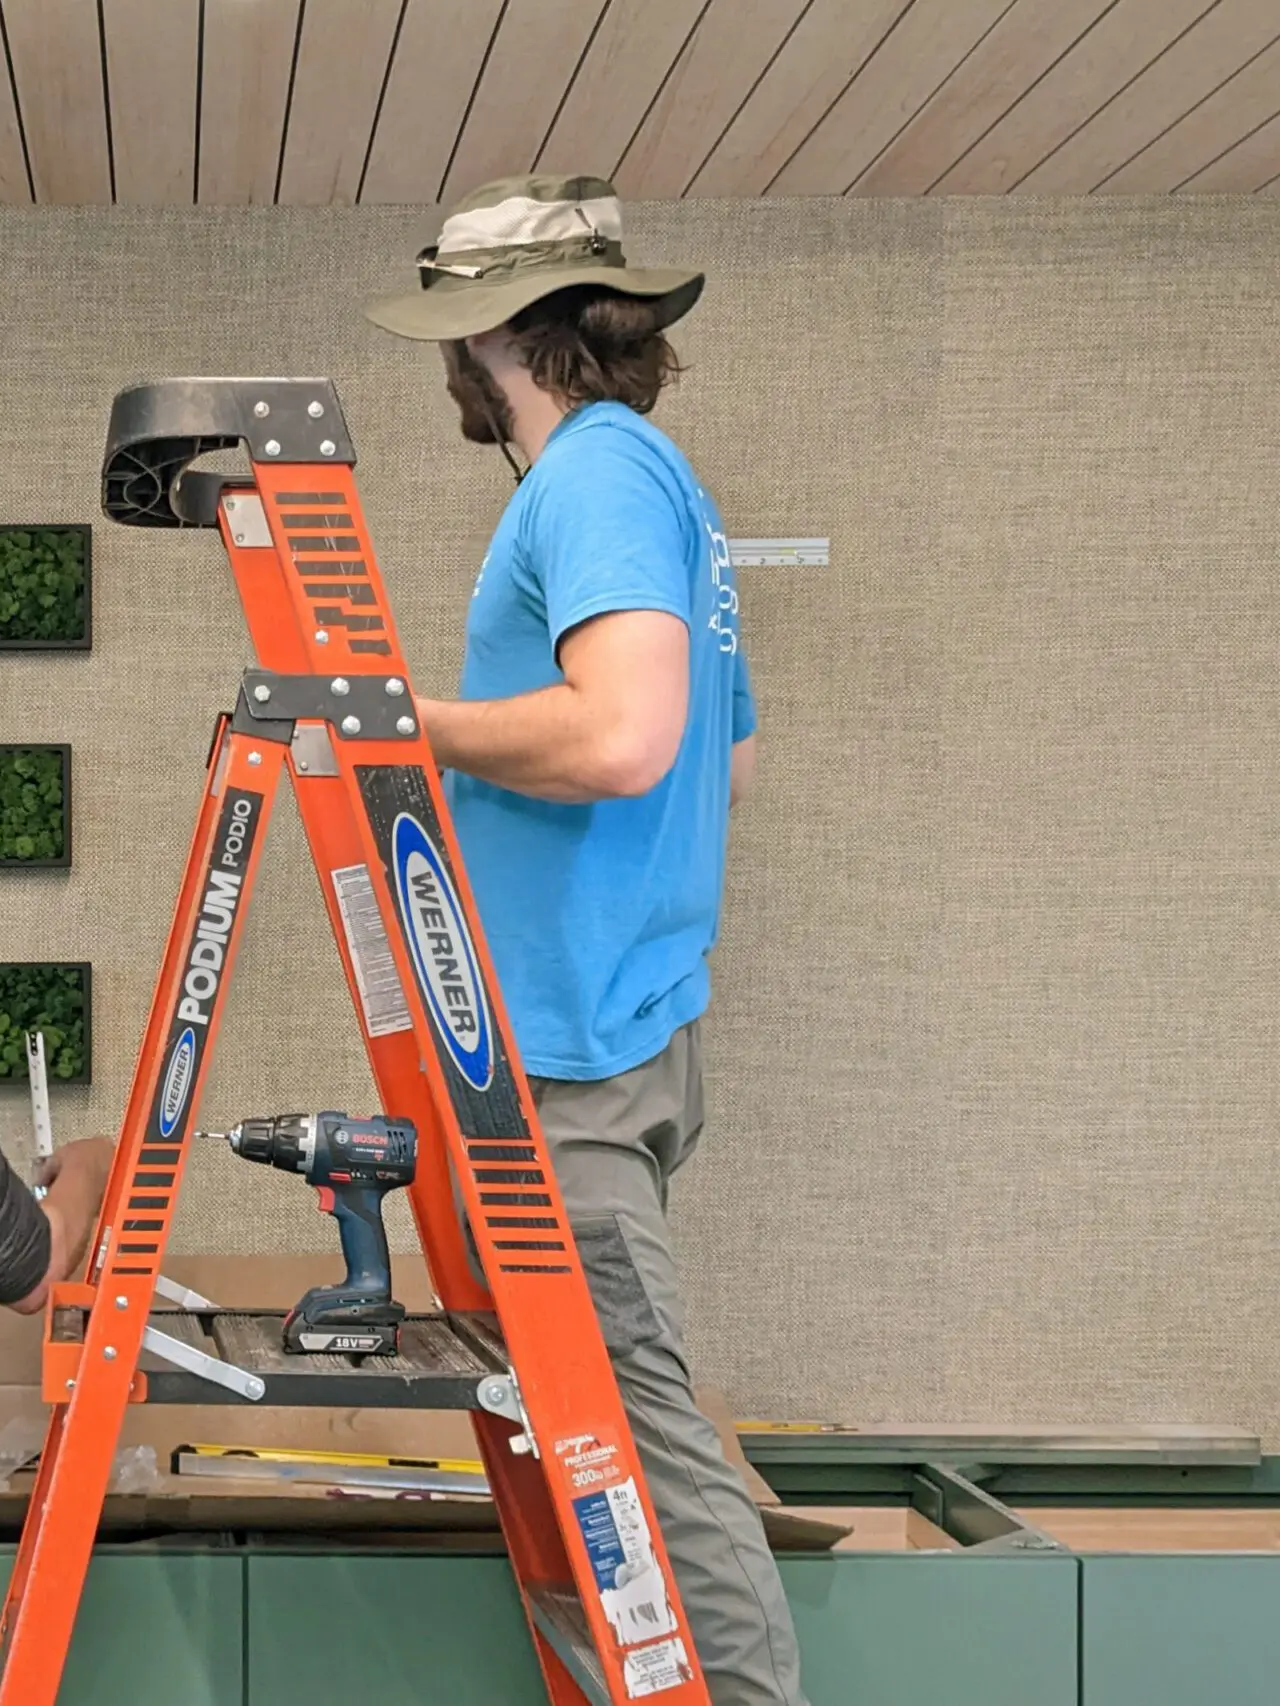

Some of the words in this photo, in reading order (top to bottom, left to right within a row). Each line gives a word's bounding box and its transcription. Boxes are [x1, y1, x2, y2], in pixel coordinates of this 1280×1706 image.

[177, 869, 242, 1025] PODIUM
[222, 798, 252, 867] PODIO
[410, 871, 477, 1036] WERNER
[166, 1048, 188, 1114] WERNER
[352, 1133, 388, 1145] BOSCH
[335, 1338, 358, 1348] 18V
